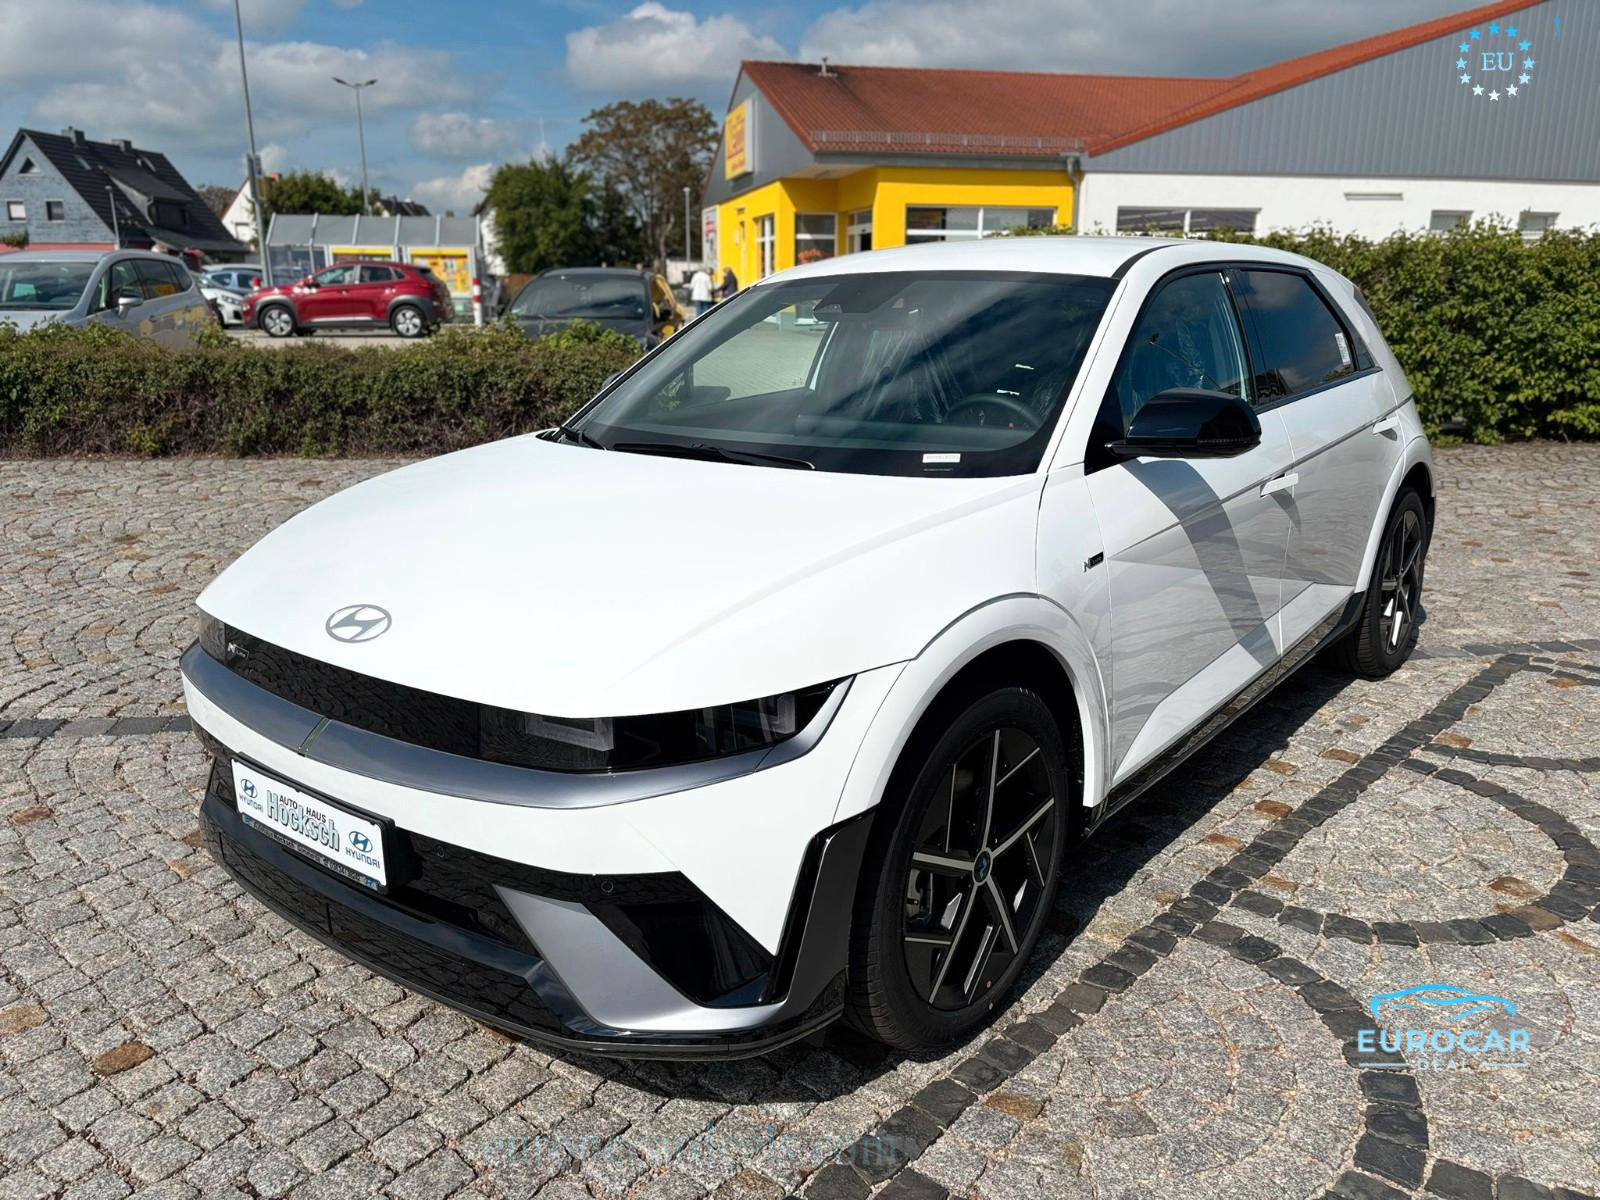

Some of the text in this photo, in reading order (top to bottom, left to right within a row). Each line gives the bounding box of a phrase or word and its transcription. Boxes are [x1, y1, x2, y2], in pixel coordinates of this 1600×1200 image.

[266, 789, 340, 852] Hocksch
[280, 794, 326, 824] AUTO HAUS
[345, 846, 381, 869] HYUNDAI
